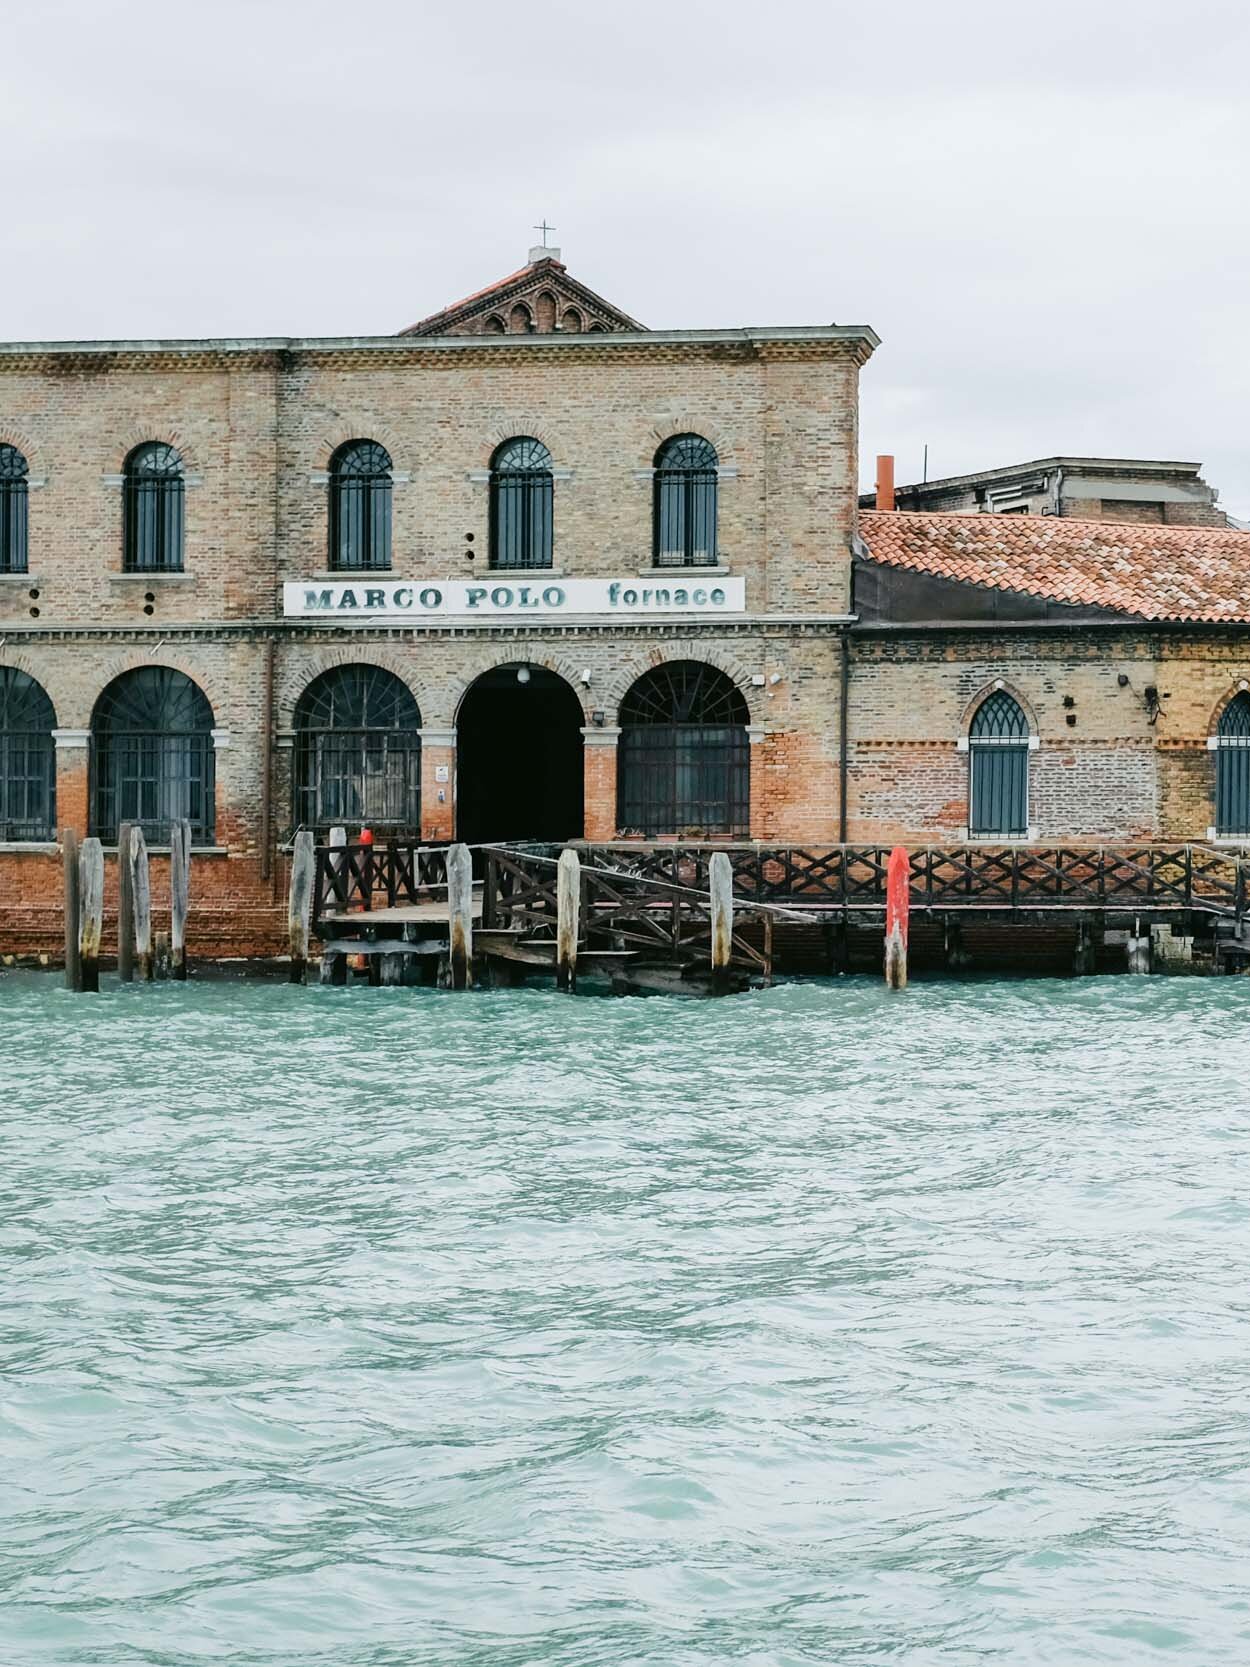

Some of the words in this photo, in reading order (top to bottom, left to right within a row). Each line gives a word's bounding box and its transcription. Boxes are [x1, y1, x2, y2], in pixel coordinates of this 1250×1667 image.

[303, 588, 443, 609] MARCO
[465, 586, 566, 608] POLO
[608, 582, 726, 607] fornace
